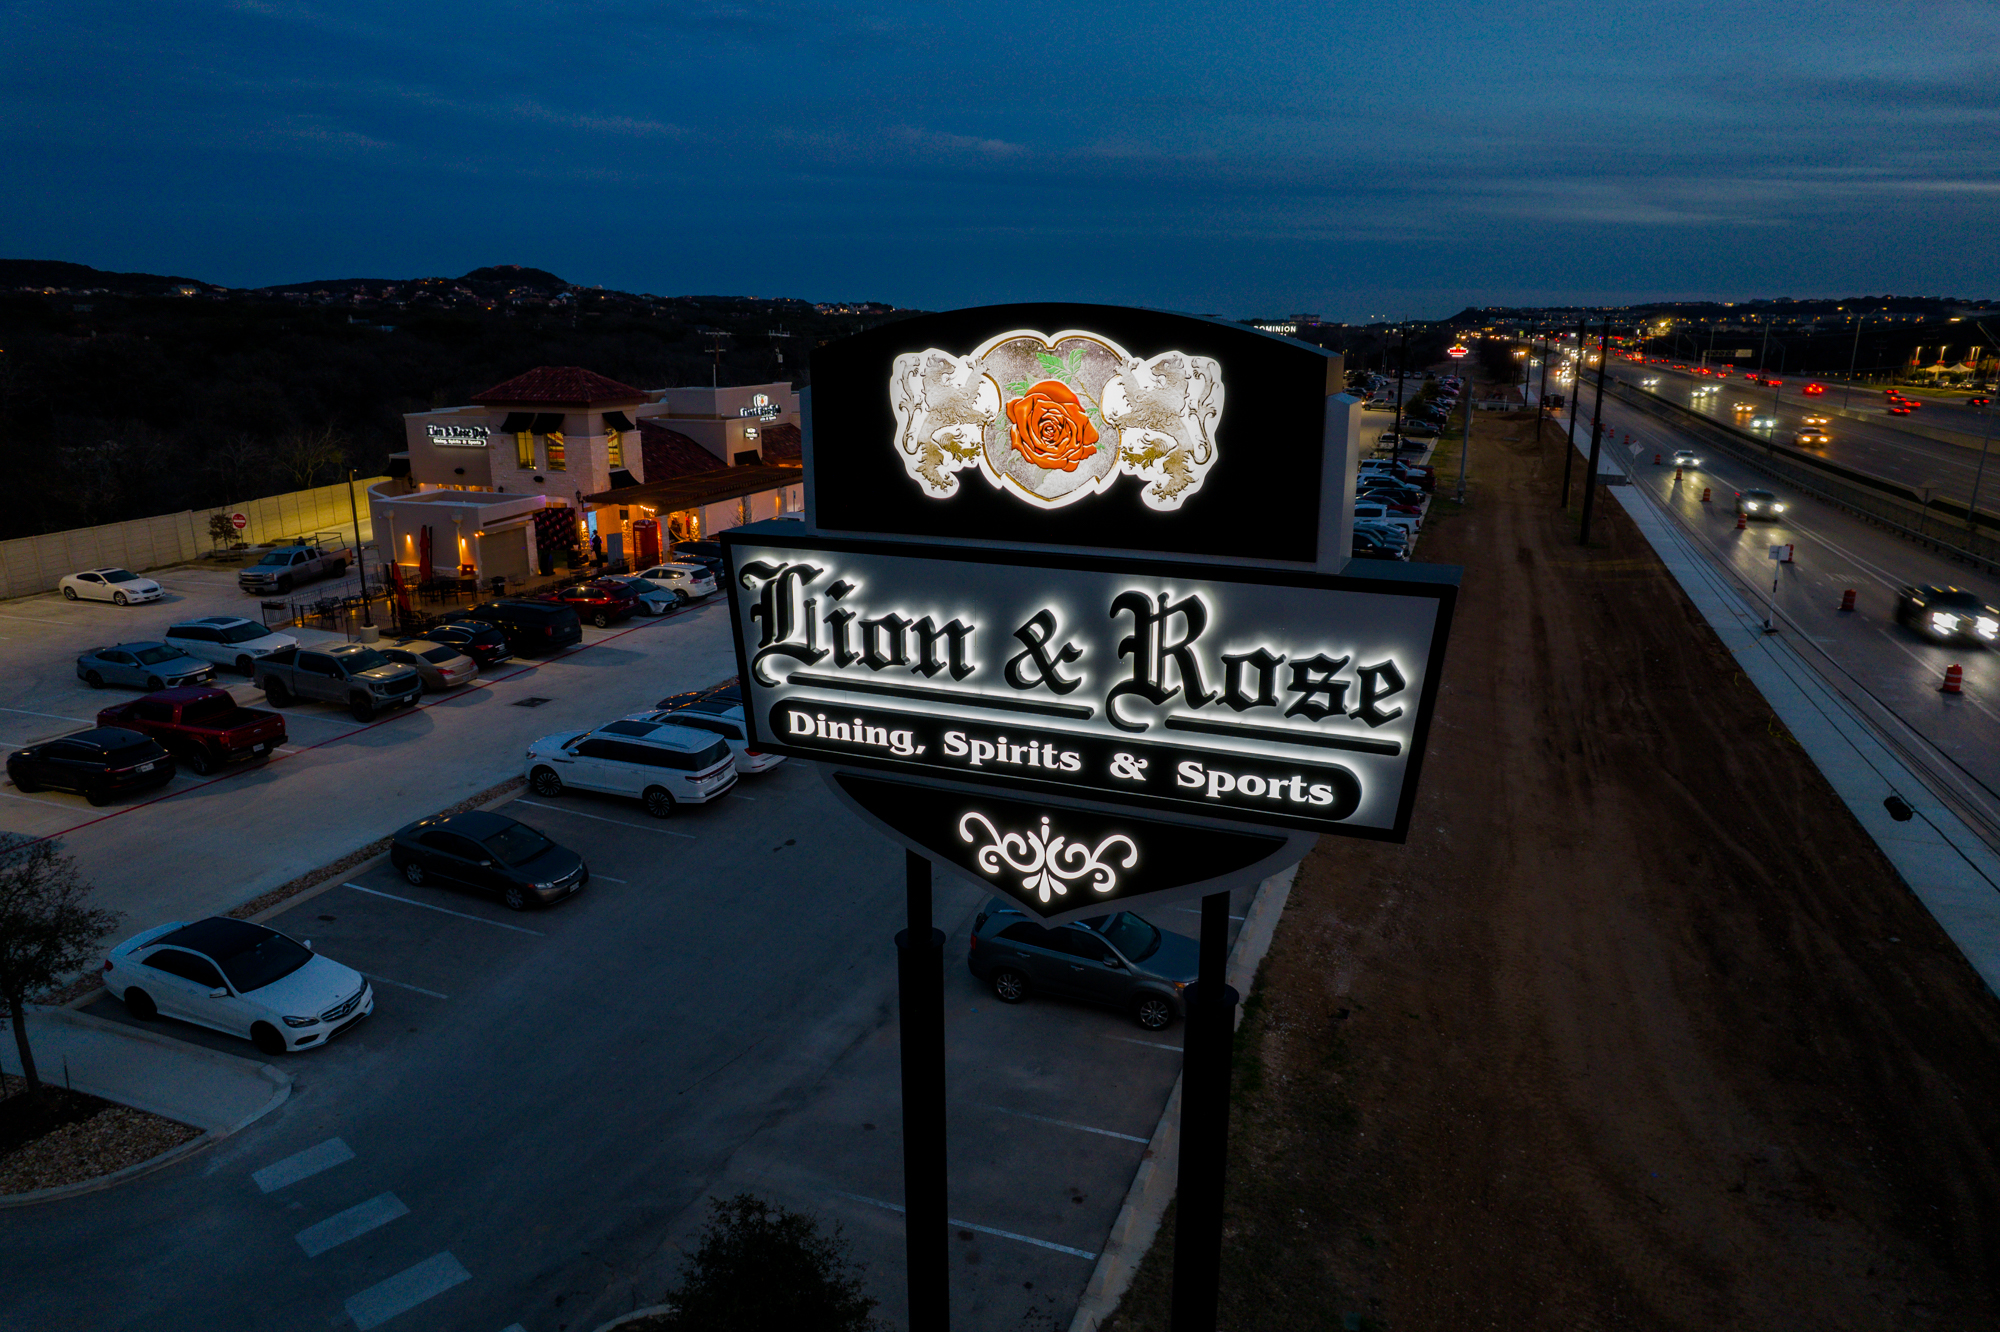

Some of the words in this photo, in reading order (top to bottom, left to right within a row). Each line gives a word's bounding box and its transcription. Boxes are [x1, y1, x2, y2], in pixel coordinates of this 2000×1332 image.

[738, 559, 976, 688] Lion
[1004, 607, 1085, 695] &
[1105, 590, 1408, 733] Rose
[787, 710, 926, 755] Dining,
[943, 731, 1082, 772] Spirits
[1109, 752, 1149, 781] &
[1176, 761, 1334, 805] Sports
